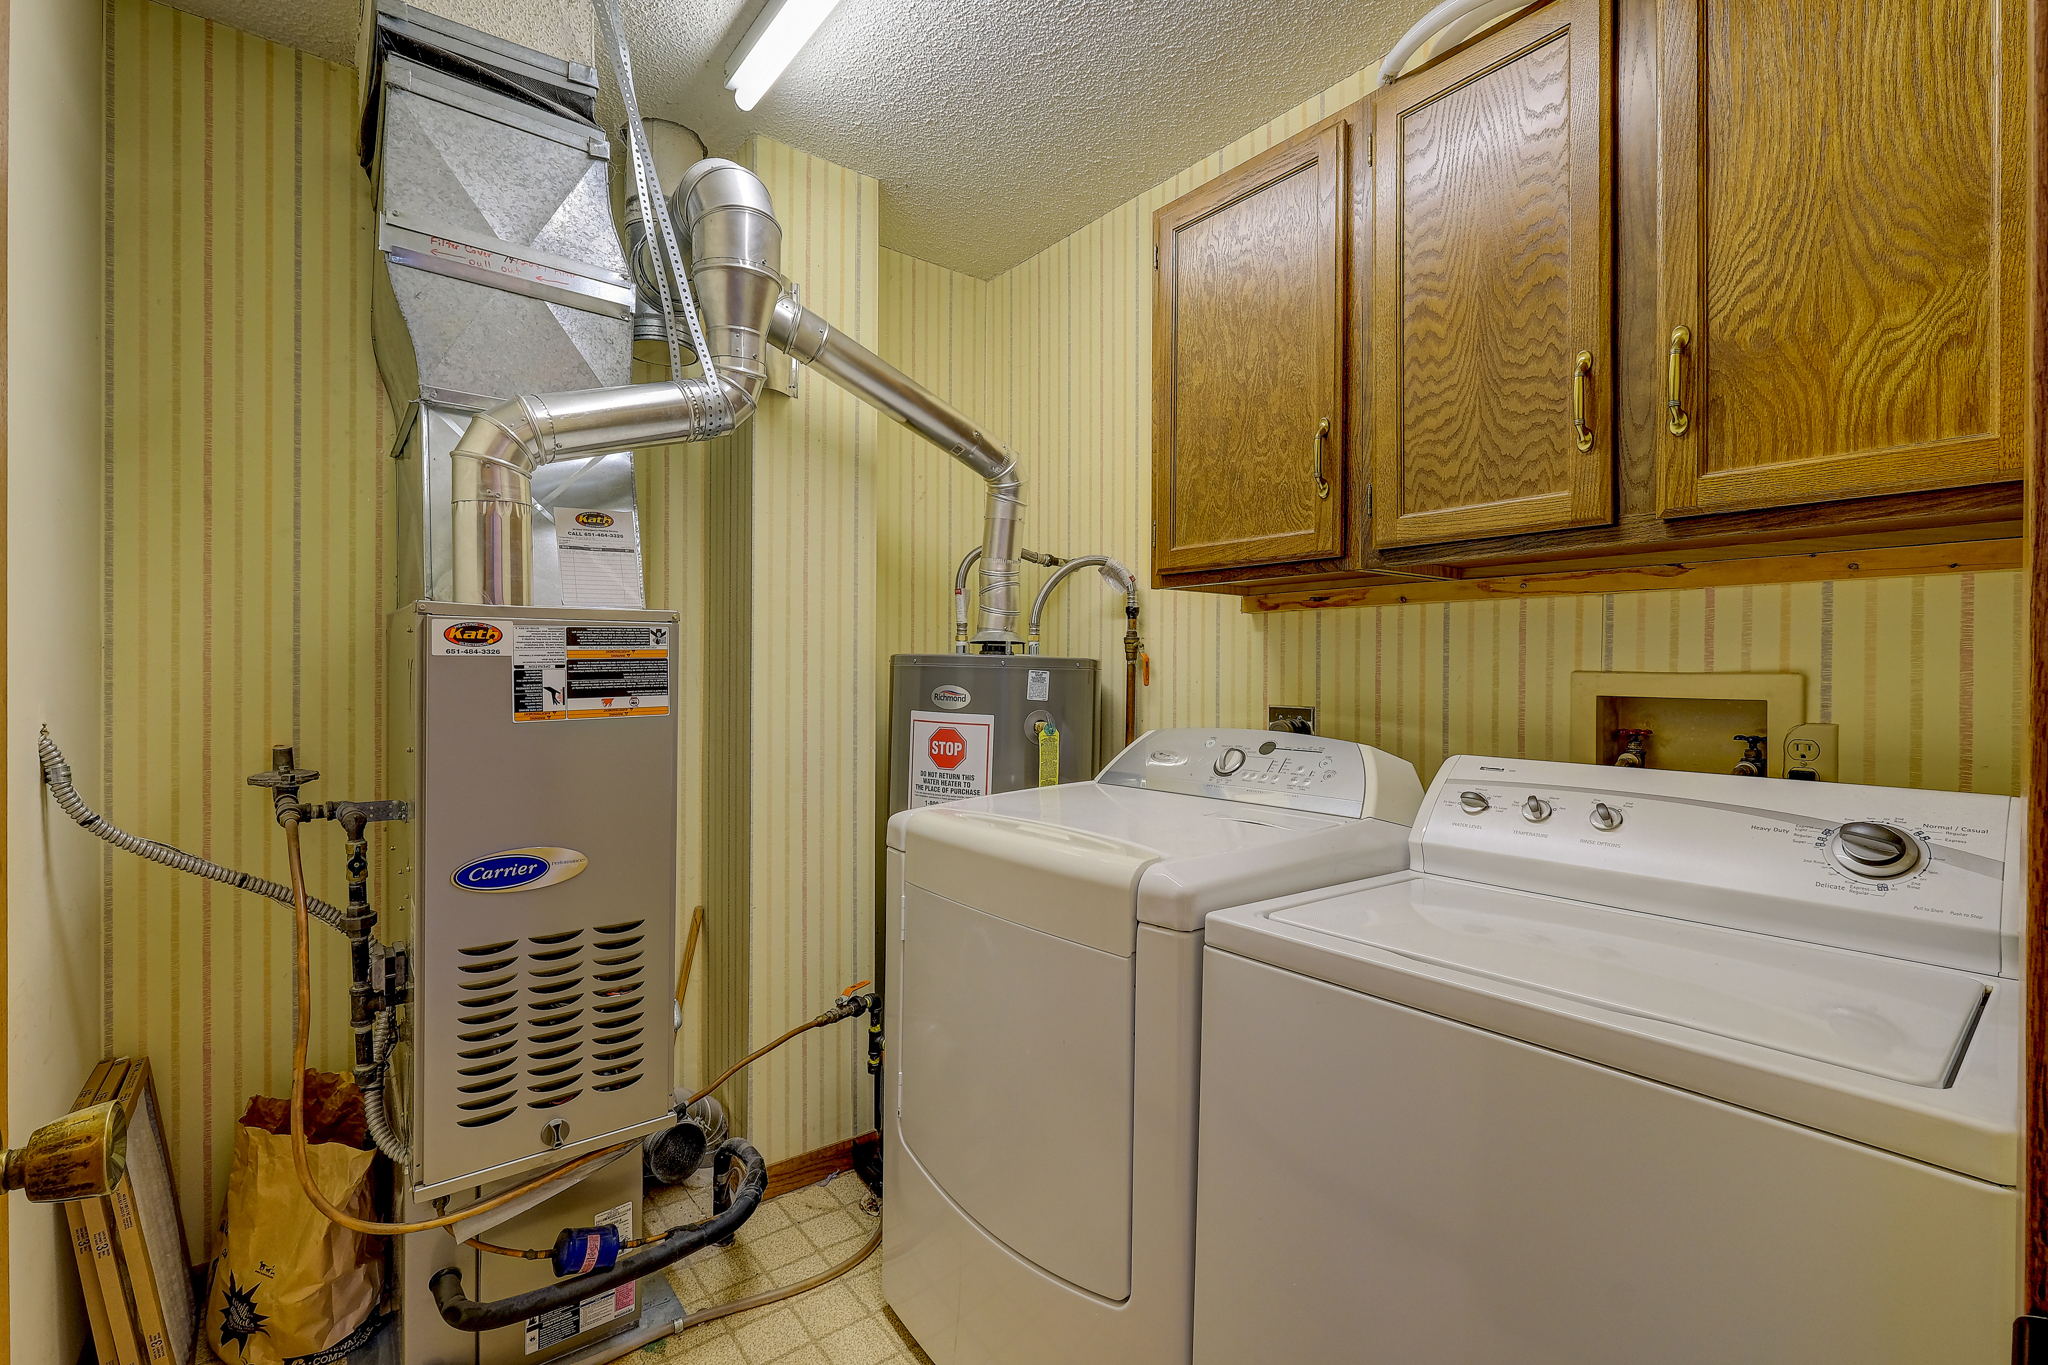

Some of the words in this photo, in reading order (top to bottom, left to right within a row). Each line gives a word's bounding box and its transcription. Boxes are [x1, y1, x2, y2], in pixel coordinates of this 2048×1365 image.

[430, 236, 460, 250] Filter
[464, 244, 493, 257] Cover
[578, 514, 613, 527] Kath
[448, 627, 499, 644] Kath
[933, 692, 967, 703] Richmond
[931, 740, 963, 756] STOP
[938, 772, 961, 780] RETURN
[922, 778, 940, 786] WATER
[940, 779, 962, 787] HEATER
[915, 783, 924, 791] THE
[924, 784, 941, 793] PLACE
[950, 788, 981, 796] PURCHASE
[1513, 829, 1549, 838] TEMPERATURE
[1596, 840, 1622, 848] OPTIONS
[468, 863, 538, 882] Carrier
[1815, 881, 1846, 891] Delicate
